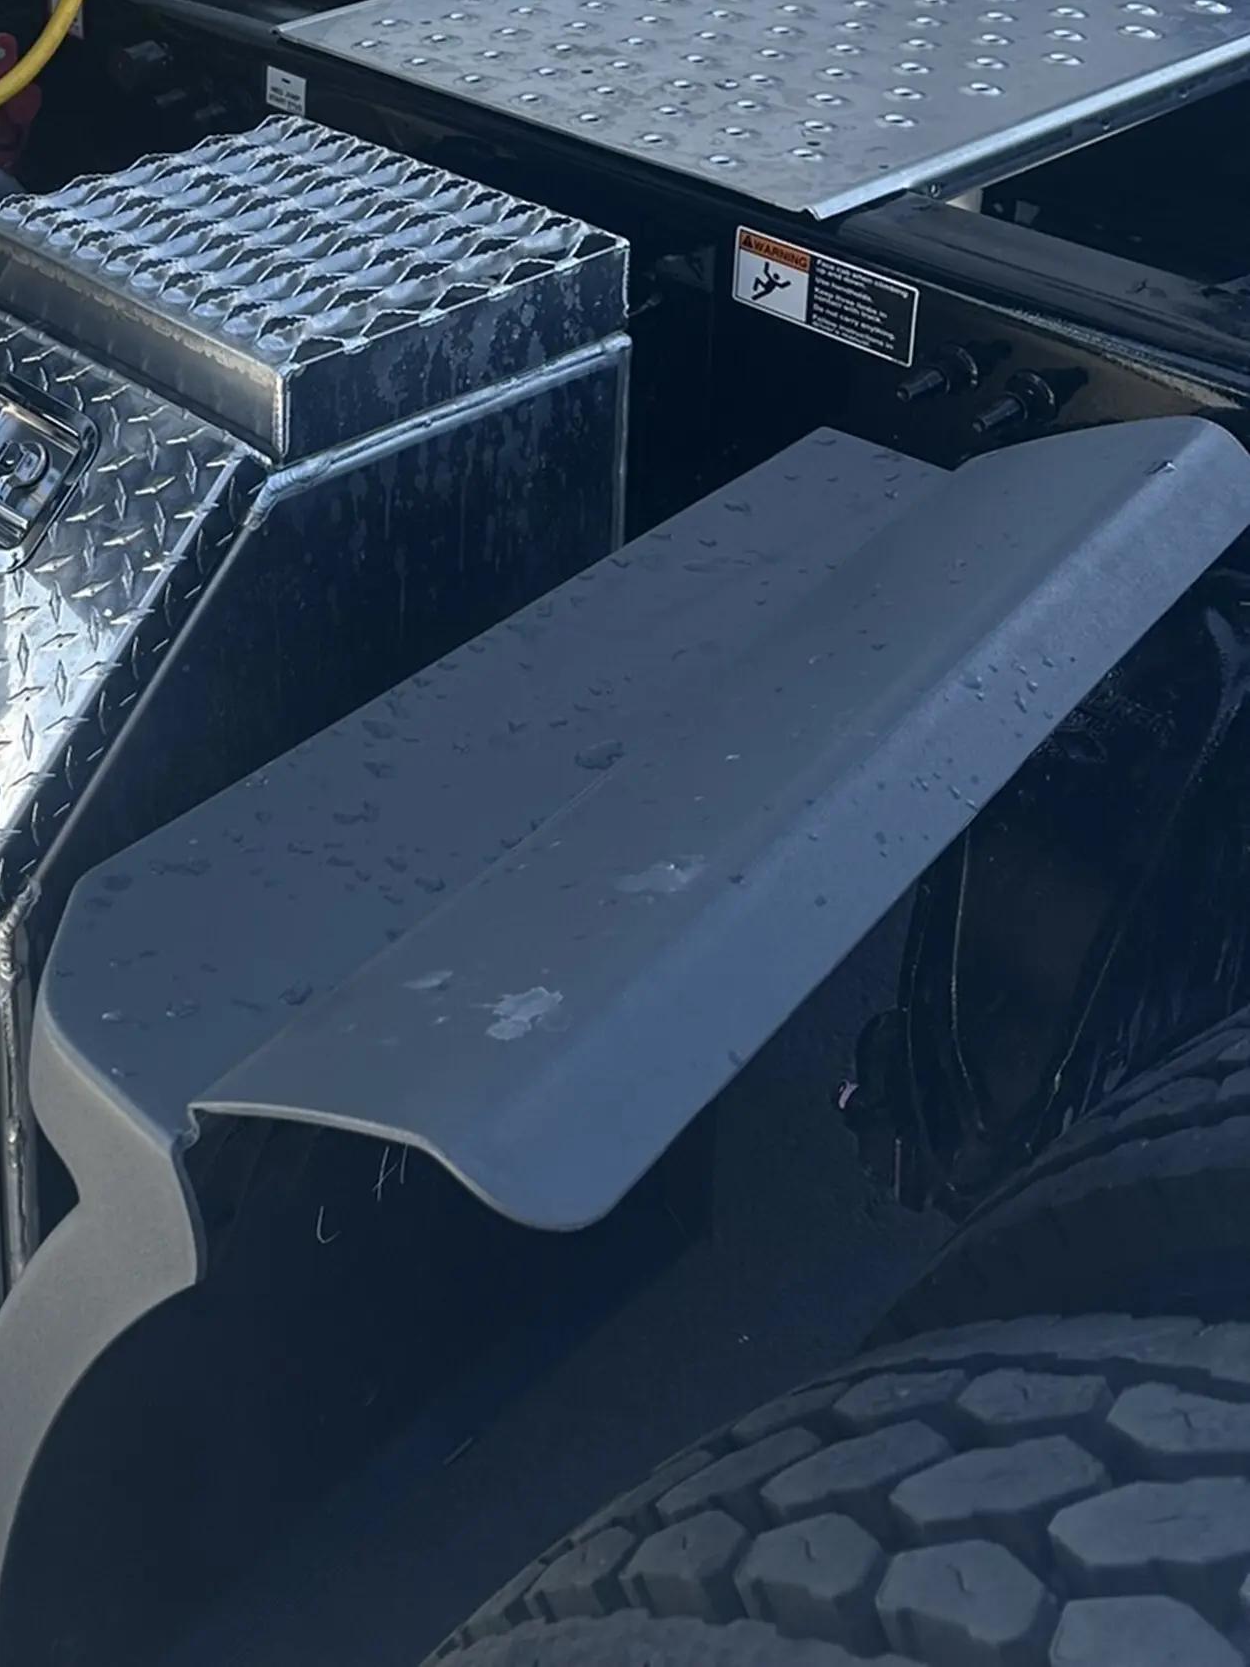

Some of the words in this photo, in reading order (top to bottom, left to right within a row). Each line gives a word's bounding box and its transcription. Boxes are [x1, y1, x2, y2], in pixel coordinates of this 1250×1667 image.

[754, 239, 807, 267] WARNING
[827, 271, 842, 281] and
[874, 280, 909, 299] climbing
[813, 303, 824, 313] Do
[825, 309, 838, 318] not
[839, 314, 859, 327] carry
